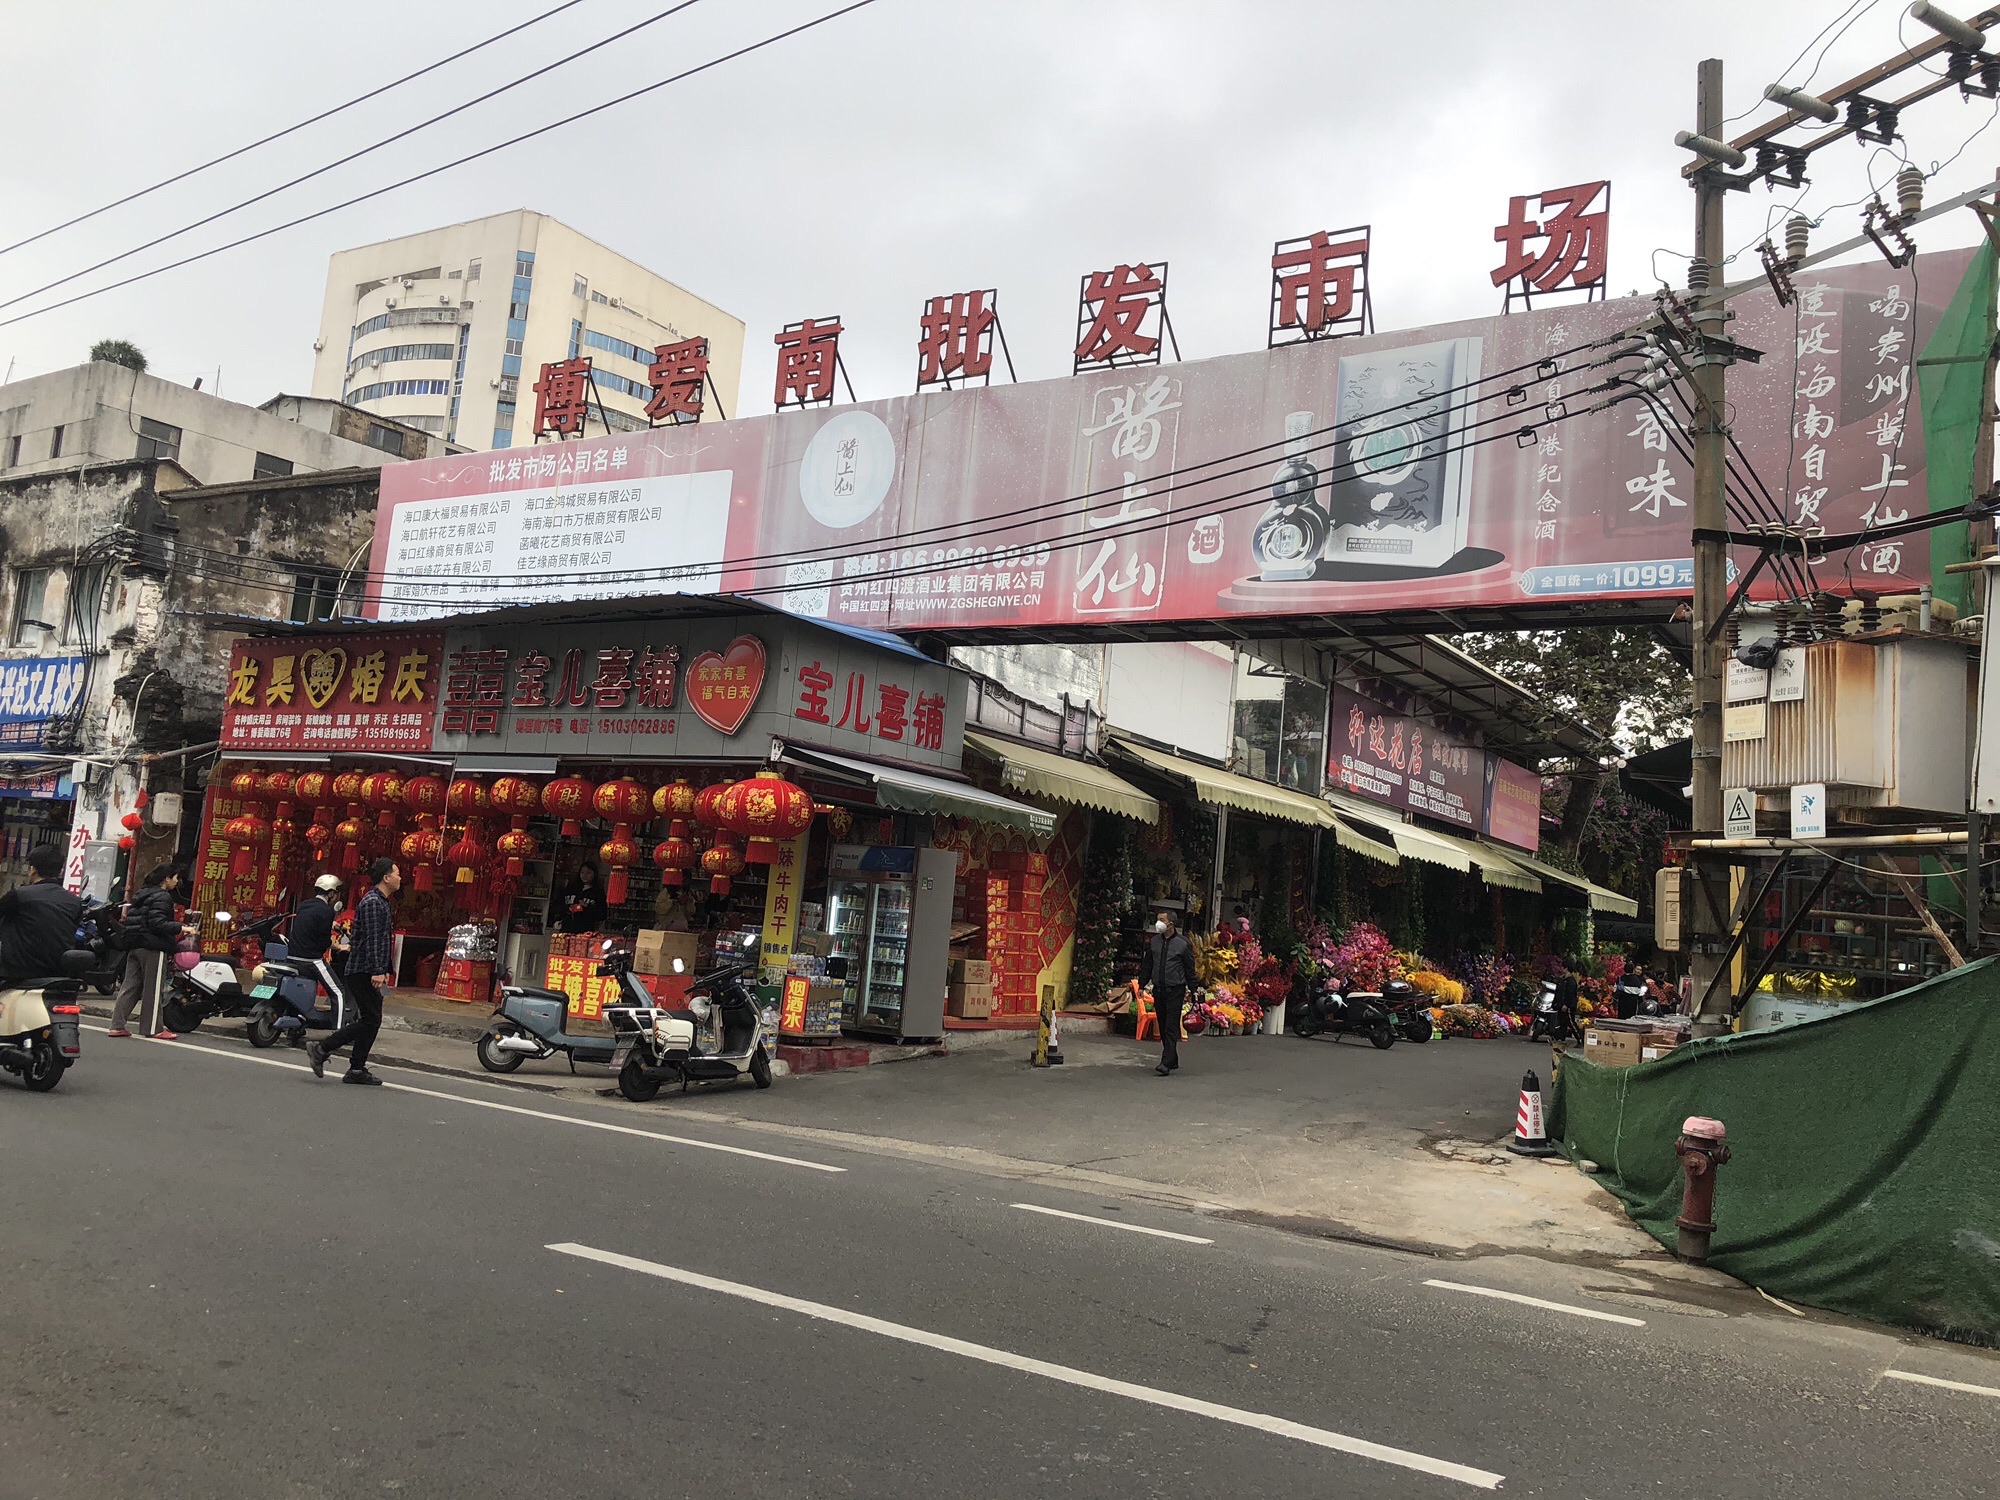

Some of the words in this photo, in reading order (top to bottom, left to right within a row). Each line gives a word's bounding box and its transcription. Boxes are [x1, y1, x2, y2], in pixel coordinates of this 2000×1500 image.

[532, 180, 1611, 436] 博爱南批发市场
[1793, 281, 1839, 565] 建设海南自贸
[488, 446, 629, 483] 批发市场公司名单
[401, 521, 497, 542] 海口航轩花艺有限公司
[521, 506, 662, 531] 海南海口市万根商贸有限公司
[403, 499, 511, 524] 海口康大福贸易有限公司
[524, 488, 642, 511] 海口金鸿城贸易有限公司
[398, 540, 494, 561] 海口红缘商贸有限公司
[517, 551, 612, 570] 佳艺缘商贸有限公司
[840, 570, 1046, 597] 贵州红四渡酒业集团有限公司
[511, 644, 680, 708] 宝儿喜铺
[698, 665, 747, 682] 家家有喜
[701, 685, 751, 700] 福气自来
[794, 661, 946, 750] 宝儿喜铺
[392, 714, 422, 726] 生日用品
[771, 835, 797, 936] 妹牛肉干
[783, 978, 805, 1029] 烟酒水
[1532, 1104, 1540, 1136] 禁止停车
